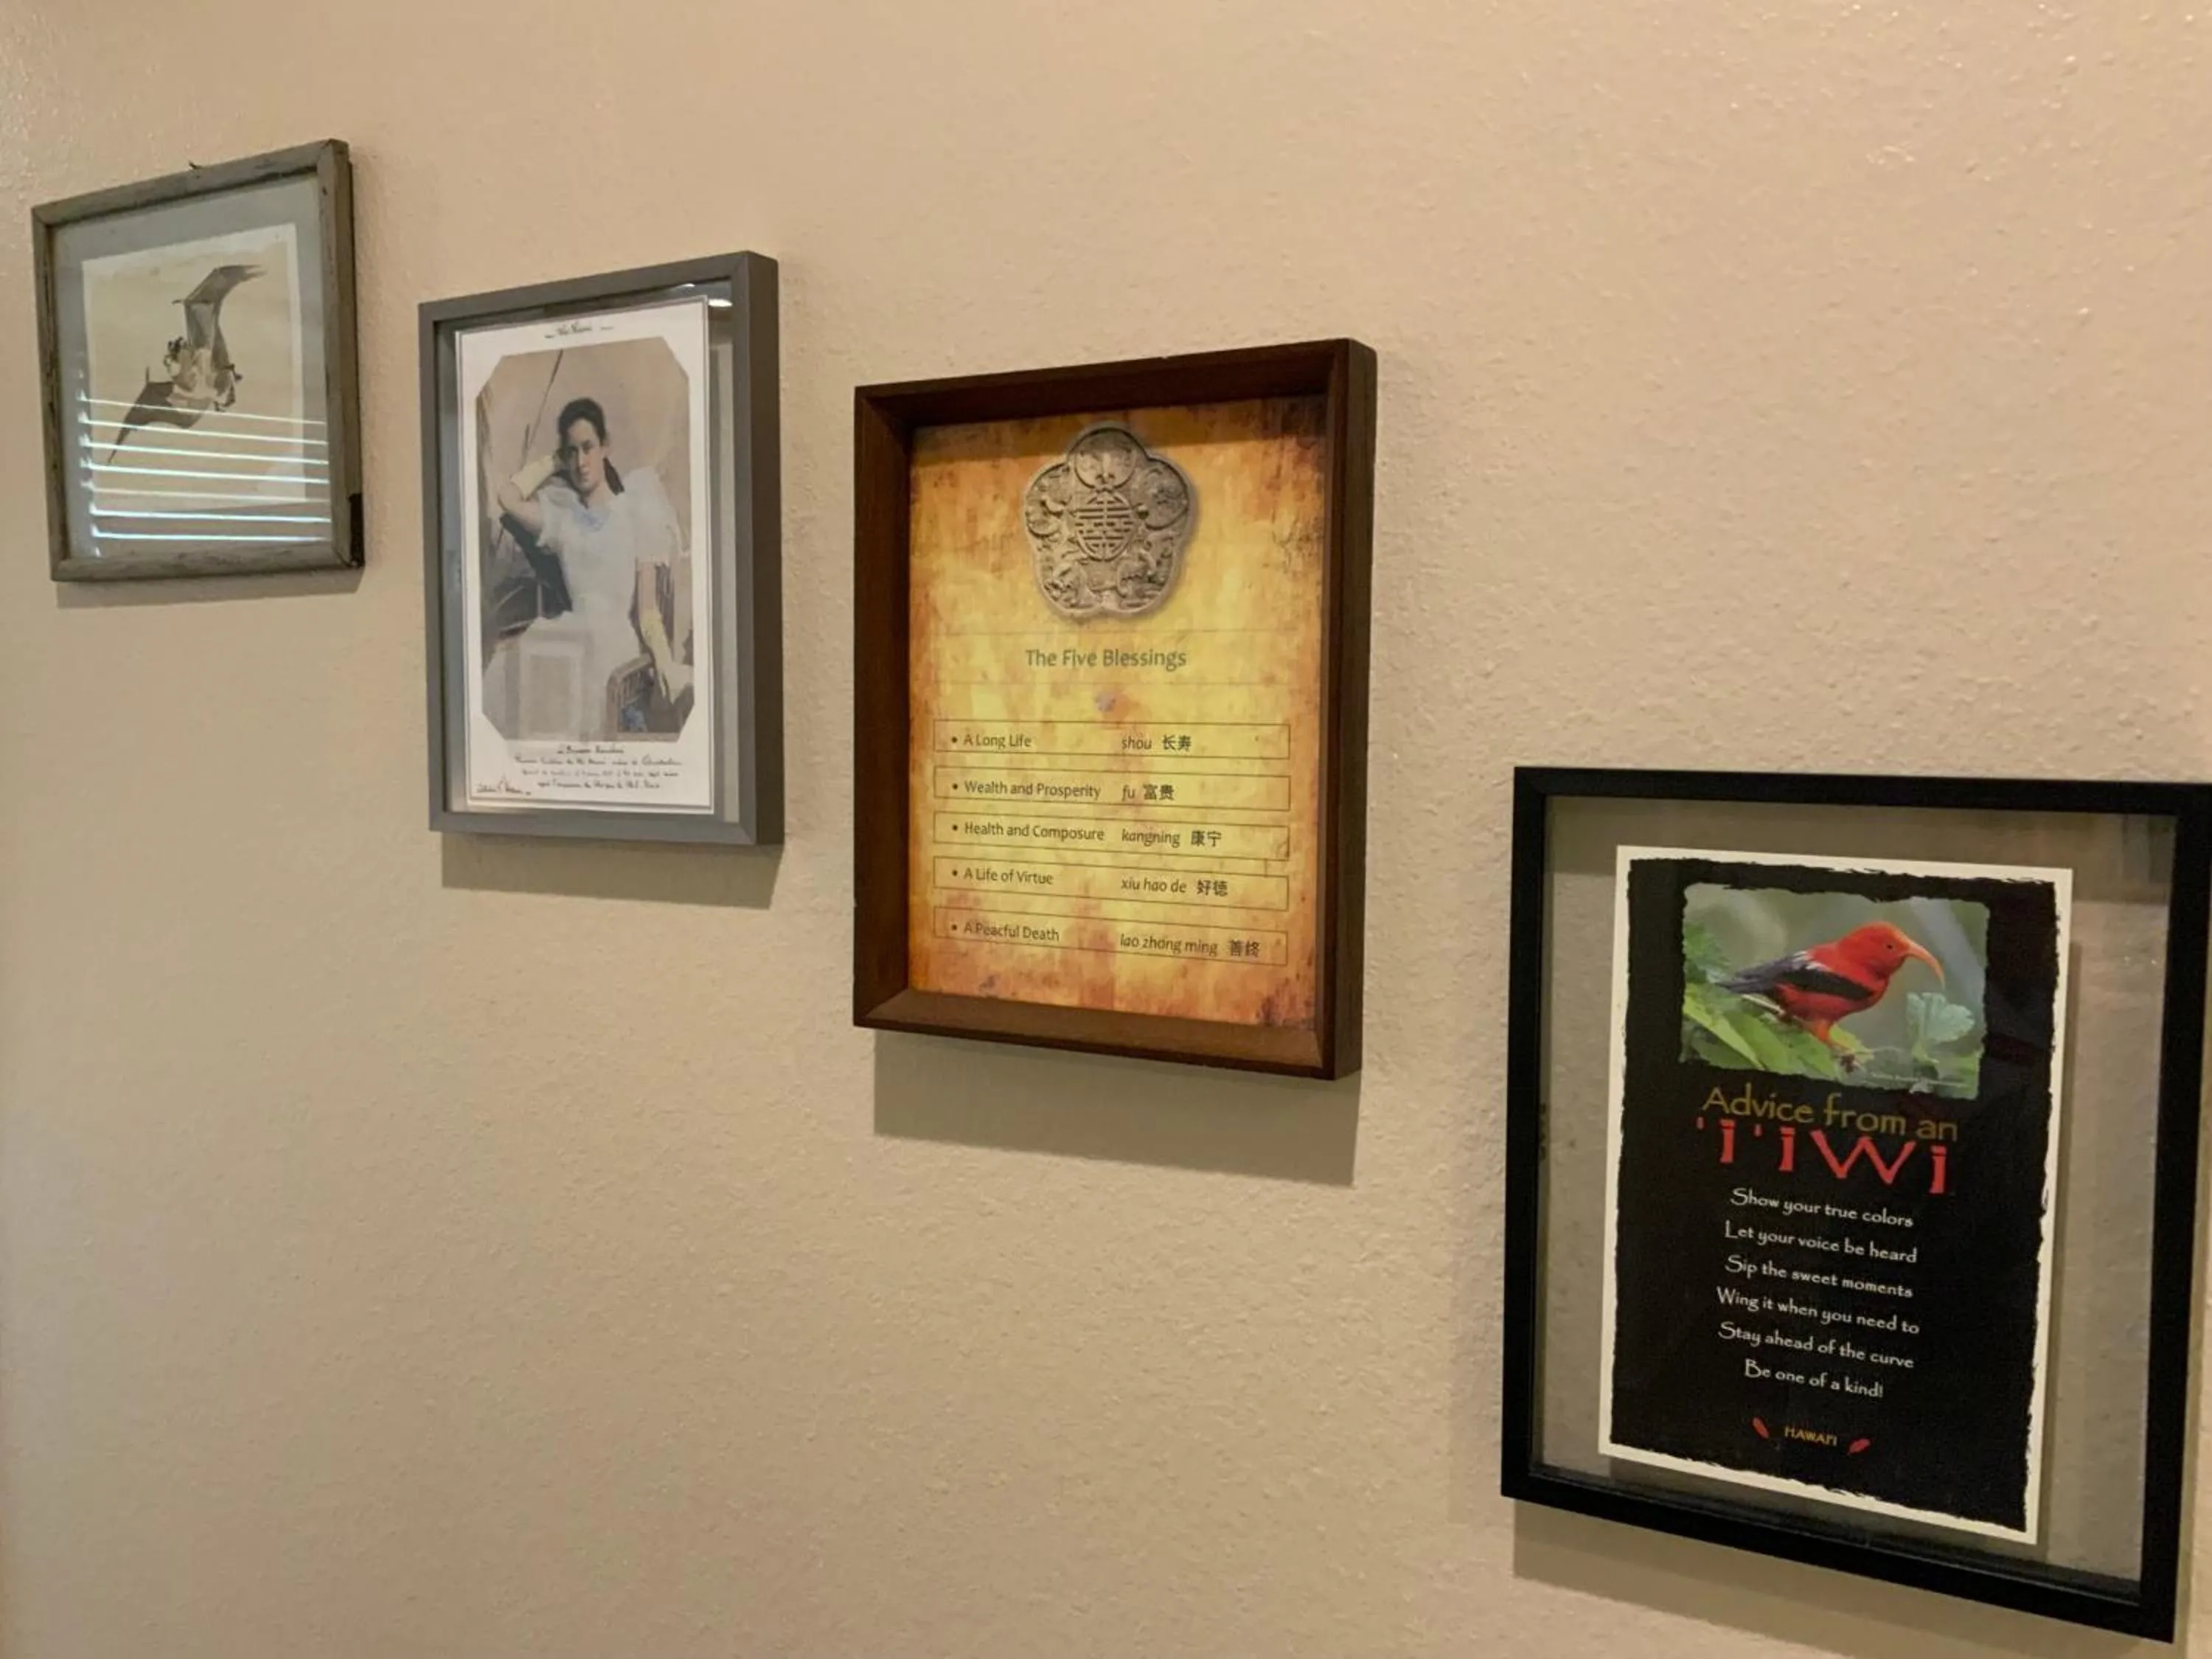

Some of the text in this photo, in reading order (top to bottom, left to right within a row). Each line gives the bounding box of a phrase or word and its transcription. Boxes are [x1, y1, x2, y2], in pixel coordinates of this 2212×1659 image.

[1026, 649, 1186, 672] The Five Blessings
[964, 734, 1032, 749] A Long Life
[1121, 736, 1152, 750] shou
[1162, 734, 1192, 751] 长寿
[964, 781, 1101, 800] Wealth and Prosperity
[1121, 785, 1135, 801] fu
[1143, 784, 1174, 800] 富贵
[964, 821, 1105, 842] Health and Composure
[1121, 829, 1180, 847] kangning
[1191, 830, 1221, 846] 康宁
[964, 868, 1054, 885] A Life of Virtue
[1121, 877, 1186, 893] xiu hao de
[1197, 880, 1228, 897] 好德
[964, 922, 973, 933] A
[1023, 926, 1060, 942] Death
[1185, 939, 1218, 956] ming
[1703, 1083, 1957, 1141] Advice from an
[1730, 1188, 1914, 1228] Show your true colors
[1724, 1220, 1918, 1263] Let your voice be heard
[1725, 1254, 1914, 1298] Sip the sweet moments
[1717, 1286, 1920, 1335] Wing it when you need to
[1717, 1321, 1914, 1368] Stay ahead of the curve
[1745, 1357, 1884, 1397] Be one of a kind!
